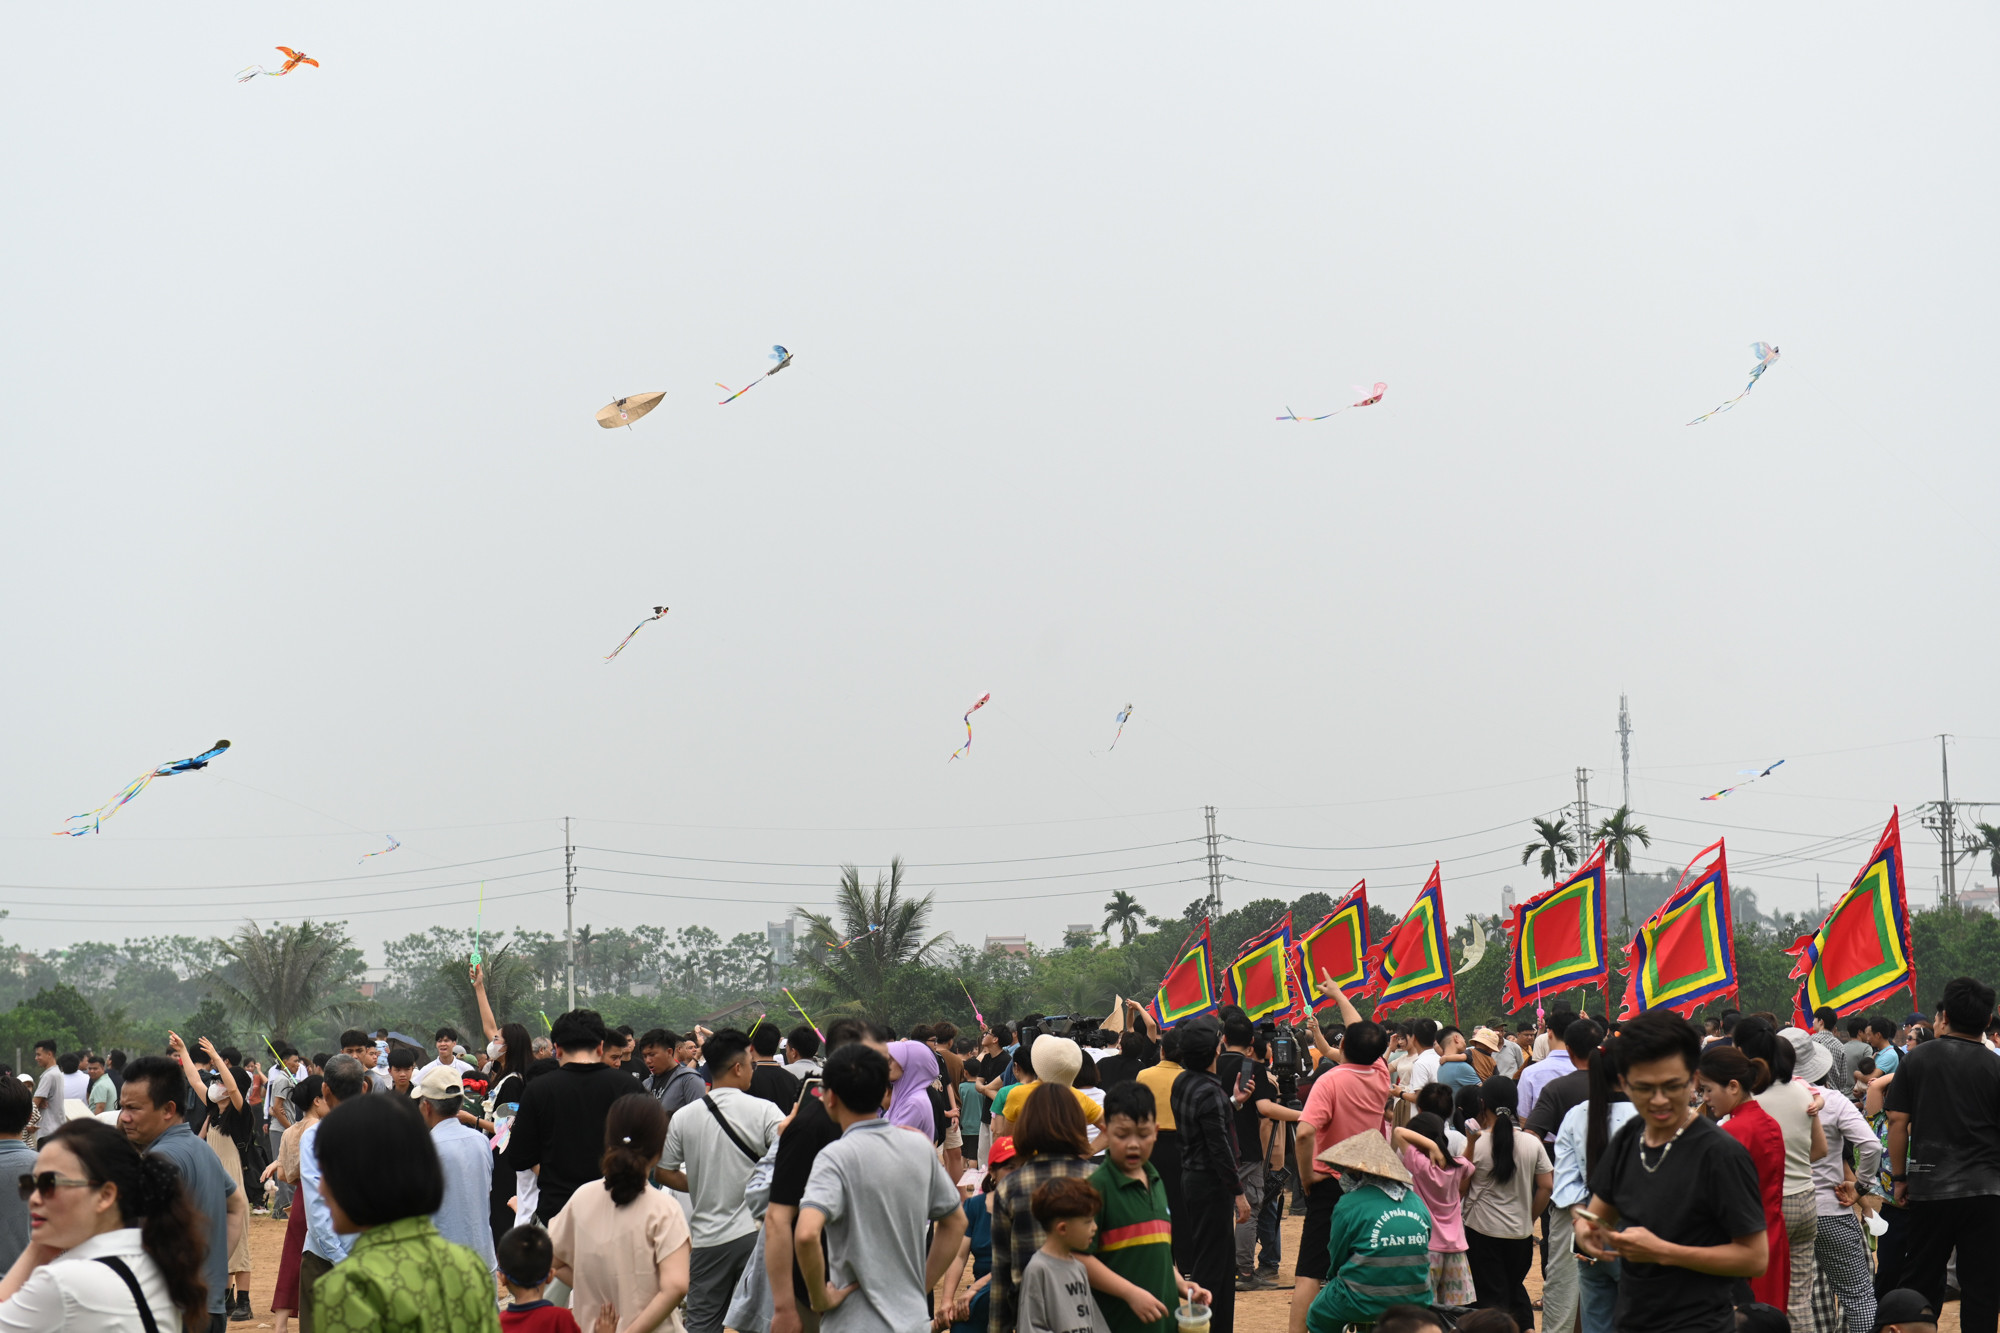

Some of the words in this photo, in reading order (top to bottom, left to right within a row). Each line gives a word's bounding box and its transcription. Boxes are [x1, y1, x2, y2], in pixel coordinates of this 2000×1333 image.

[1375, 1219, 1384, 1229] TY
[1380, 1234, 1406, 1247] TÂN
[1408, 1232, 1426, 1246] HỘI
